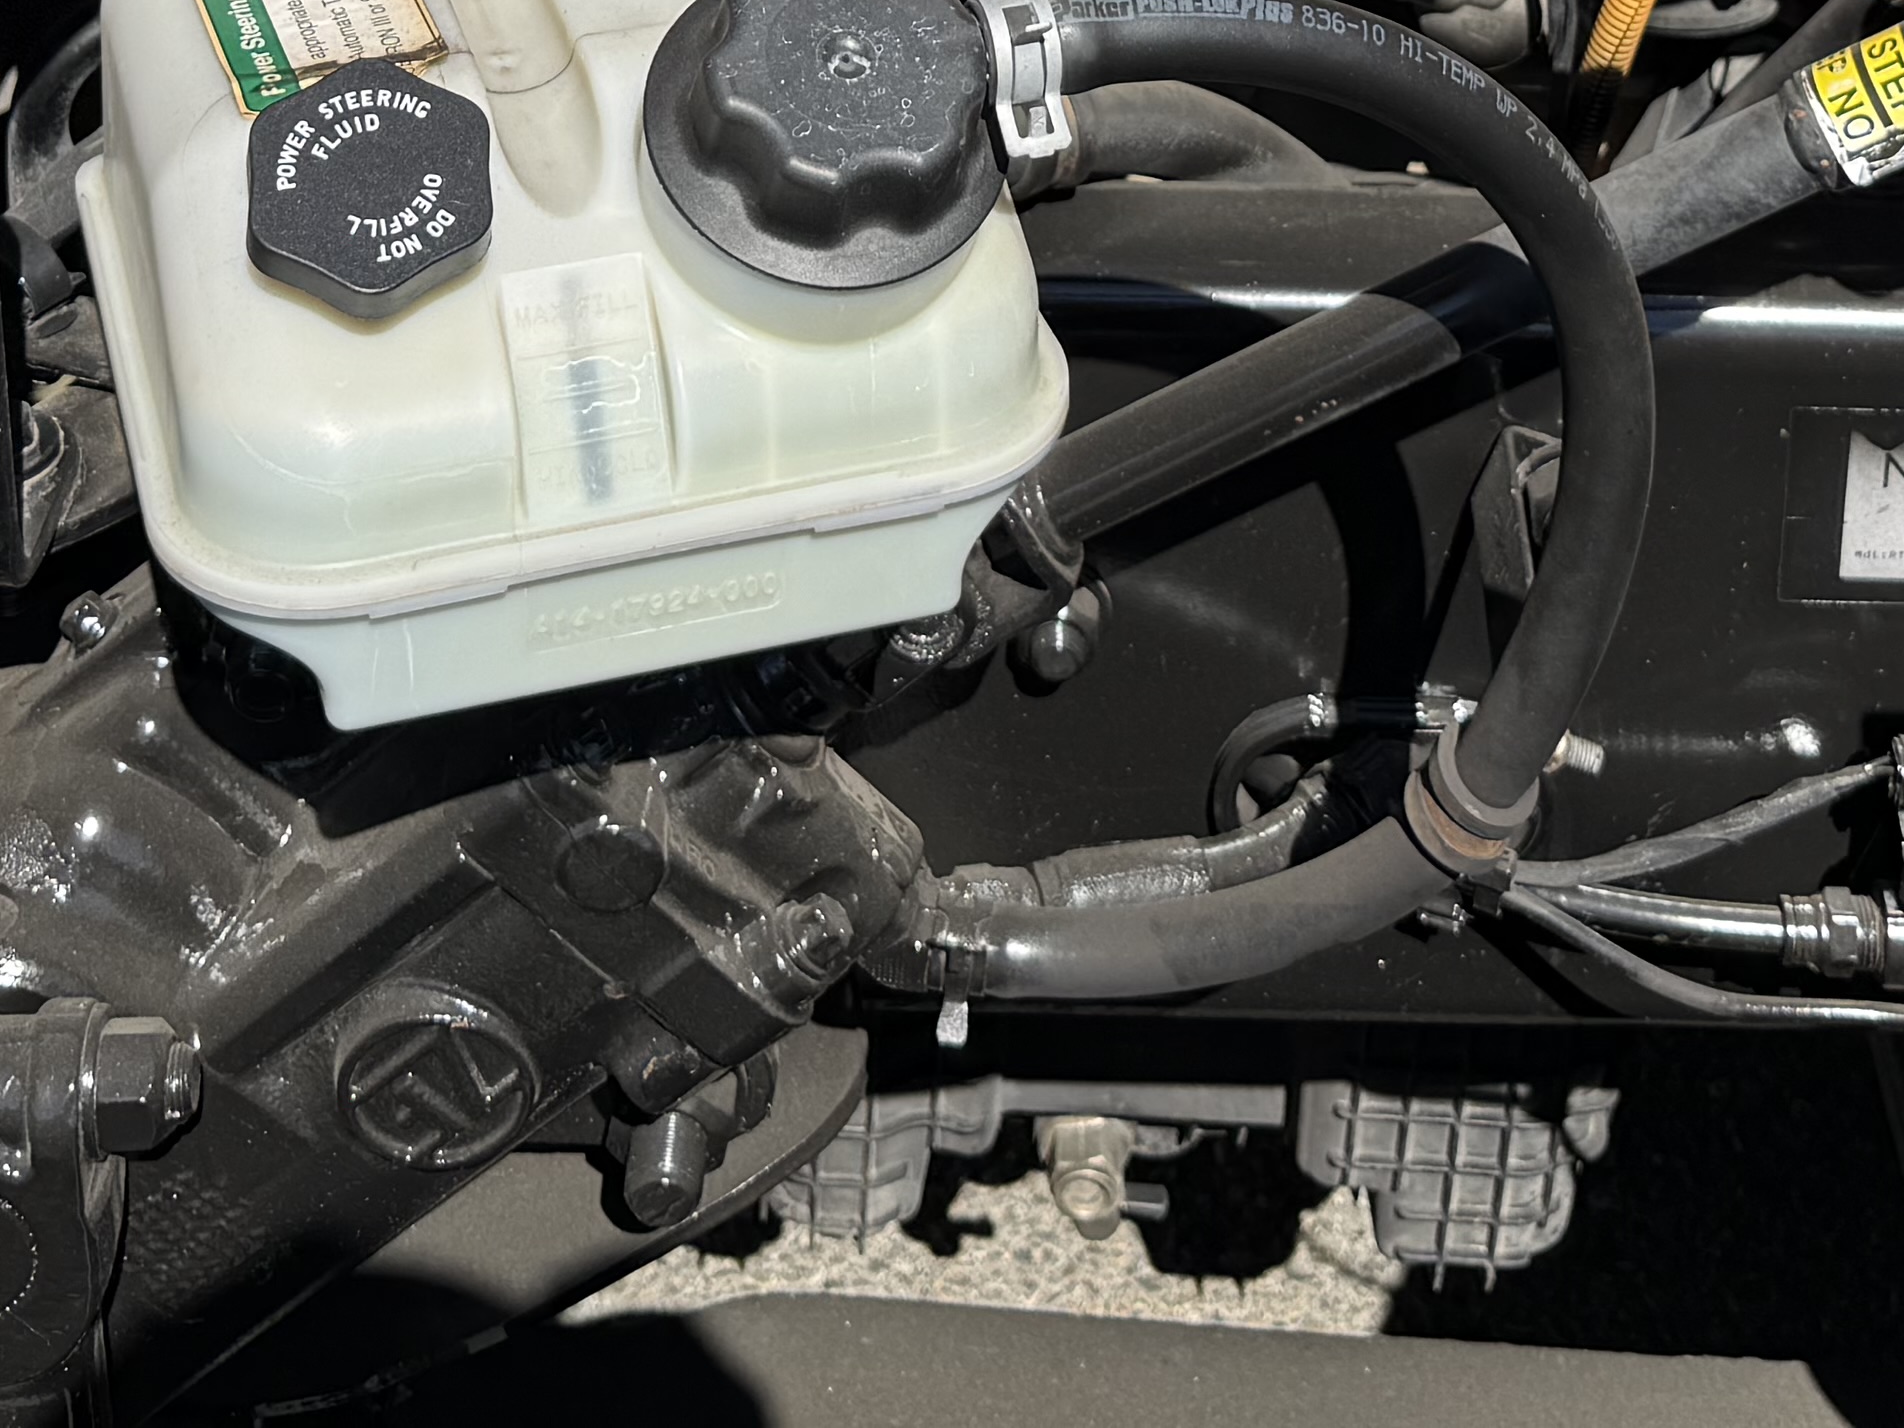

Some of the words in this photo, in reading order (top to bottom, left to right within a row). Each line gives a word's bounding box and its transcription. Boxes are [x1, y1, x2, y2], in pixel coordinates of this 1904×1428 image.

[368, 2, 387, 16] or
[370, 13, 392, 29] III
[250, 50, 288, 98] Power
[1301, 3, 1386, 46] 836-10
[1399, 33, 1486, 92] HI-TEMP
[1496, 87, 1518, 117] WP
[310, 113, 380, 161] FLUID
[1827, 86, 1875, 140] NO
[276, 119, 316, 192] POWER
[317, 89, 432, 121] STEERING
[346, 172, 443, 239] OVERFILL
[425, 208, 457, 239] DO
[376, 233, 424, 263] NOT
